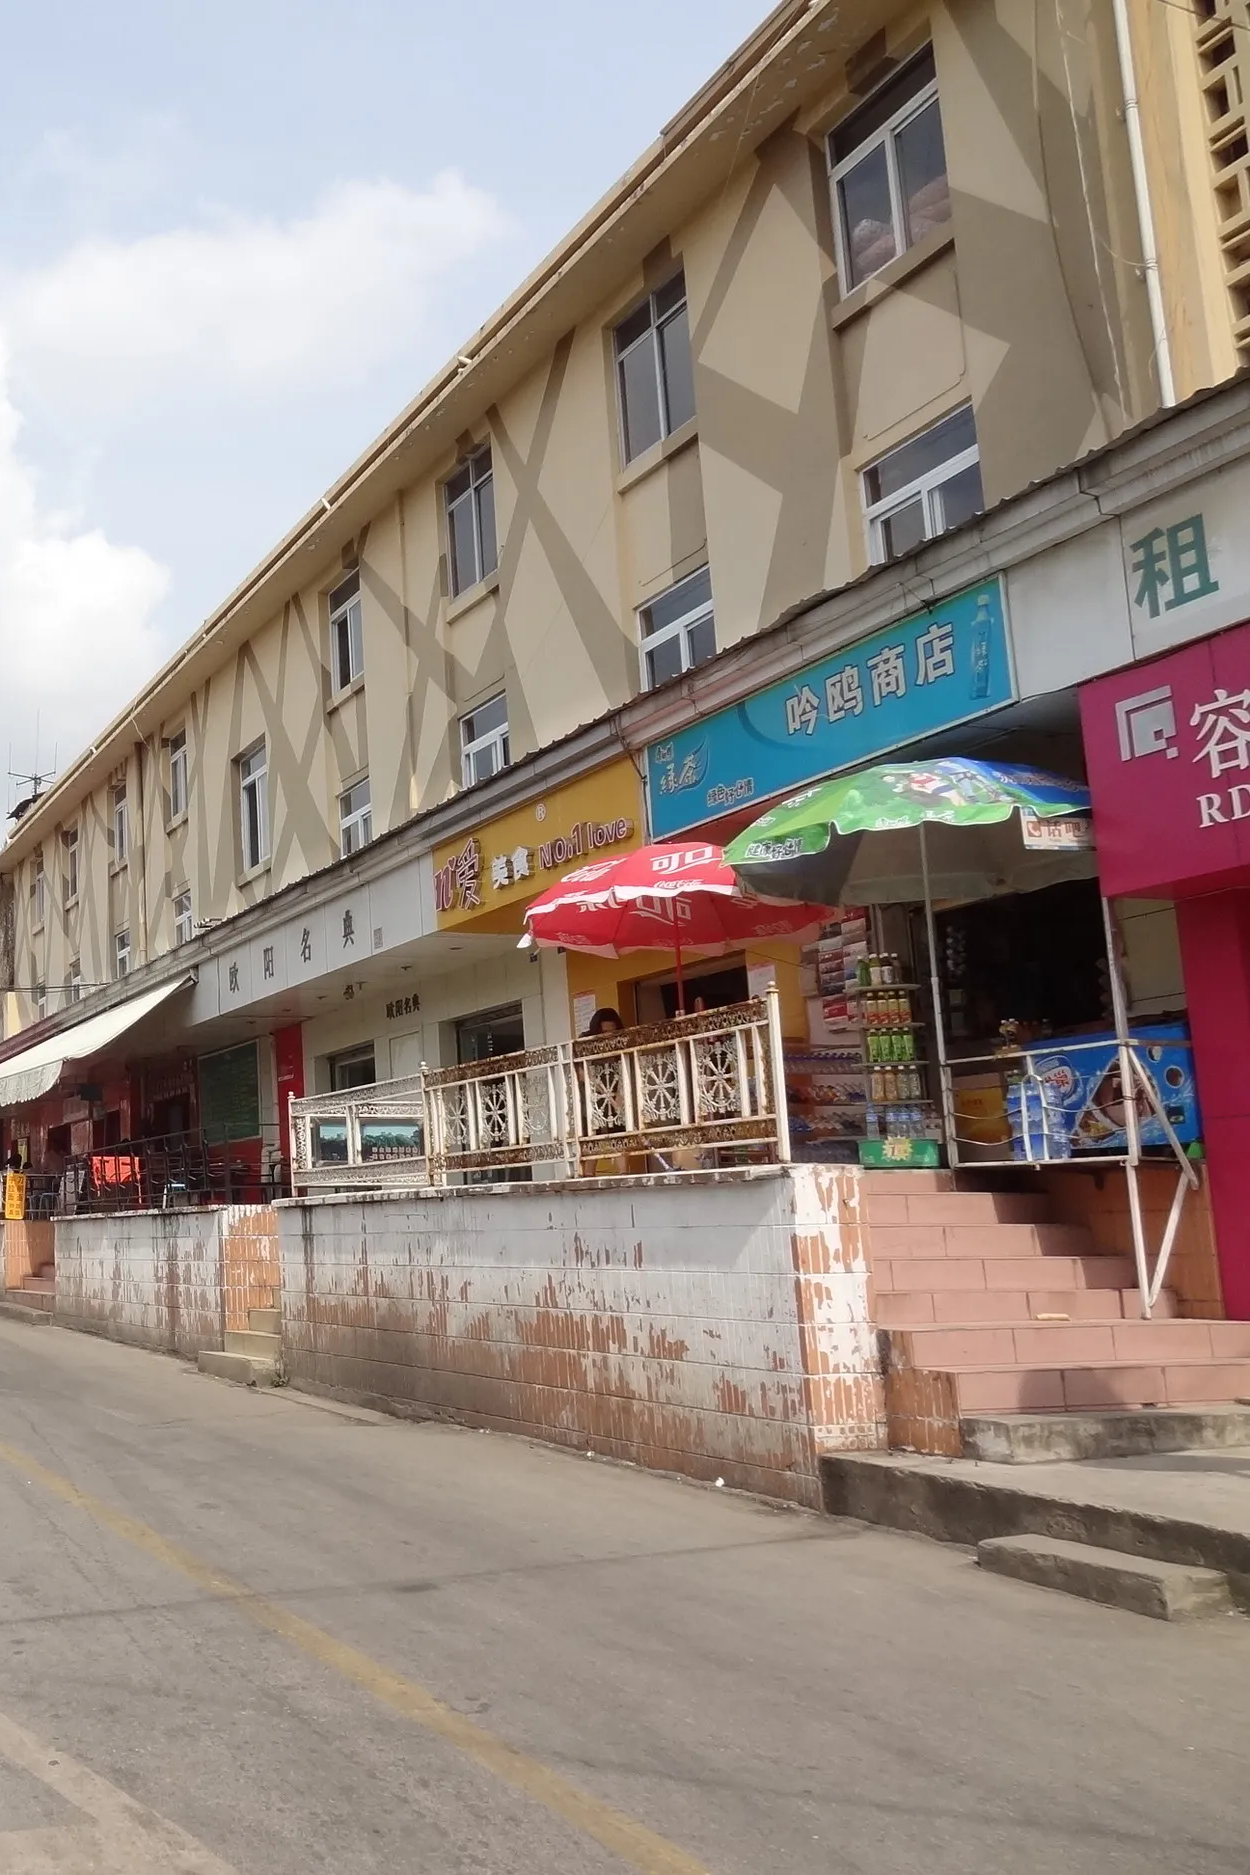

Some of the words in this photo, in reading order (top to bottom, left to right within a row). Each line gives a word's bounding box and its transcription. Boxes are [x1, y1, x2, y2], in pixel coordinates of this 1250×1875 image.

[1129, 513, 1219, 619] 租
[785, 622, 955, 735] 吟鸥商店
[492, 846, 530, 890] 美食
[587, 817, 628, 849] love
[650, 846, 713, 874] 可口
[228, 909, 354, 994] 欧阳名典
[386, 993, 421, 1020] 欧阳名典
